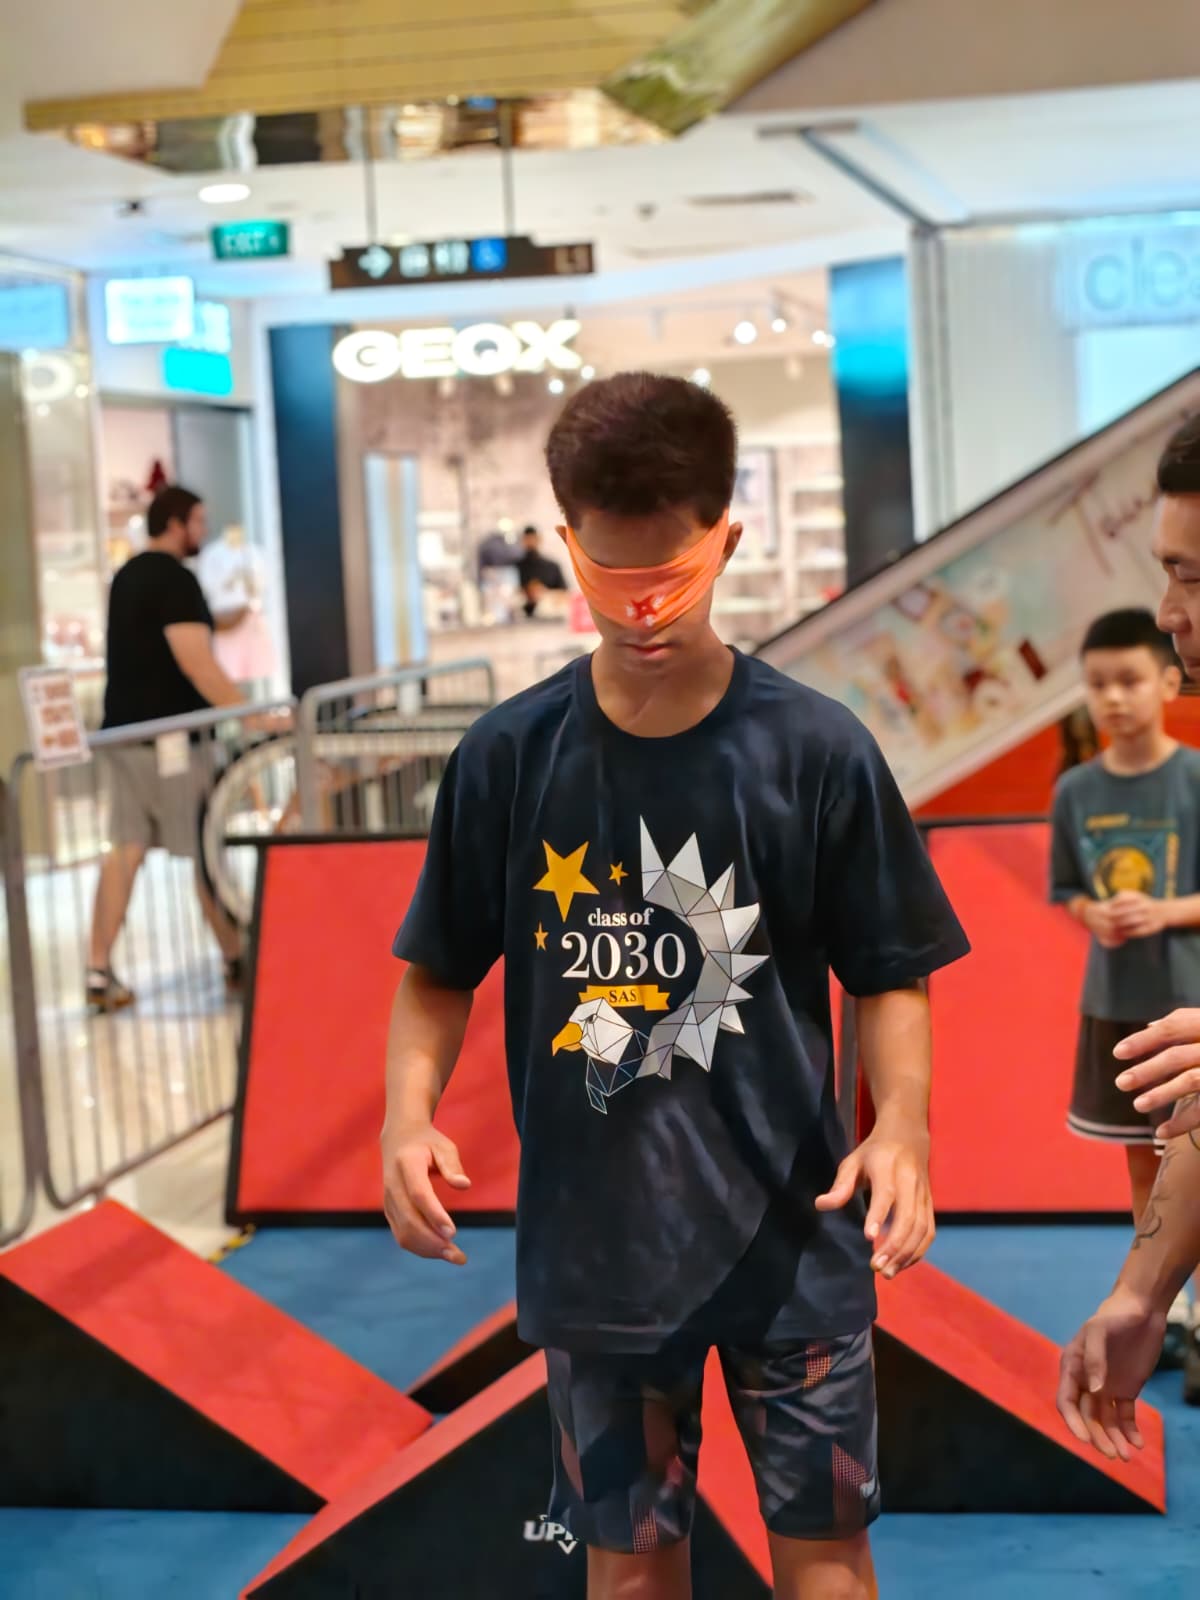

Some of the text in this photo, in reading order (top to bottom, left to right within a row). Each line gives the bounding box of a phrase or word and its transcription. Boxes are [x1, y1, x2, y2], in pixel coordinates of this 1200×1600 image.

[1083, 235, 1200, 312] cle
[332, 319, 582, 383] GEOX
[588, 907, 655, 927] class of
[560, 931, 687, 980] 2030
[608, 989, 637, 1003] SAS
